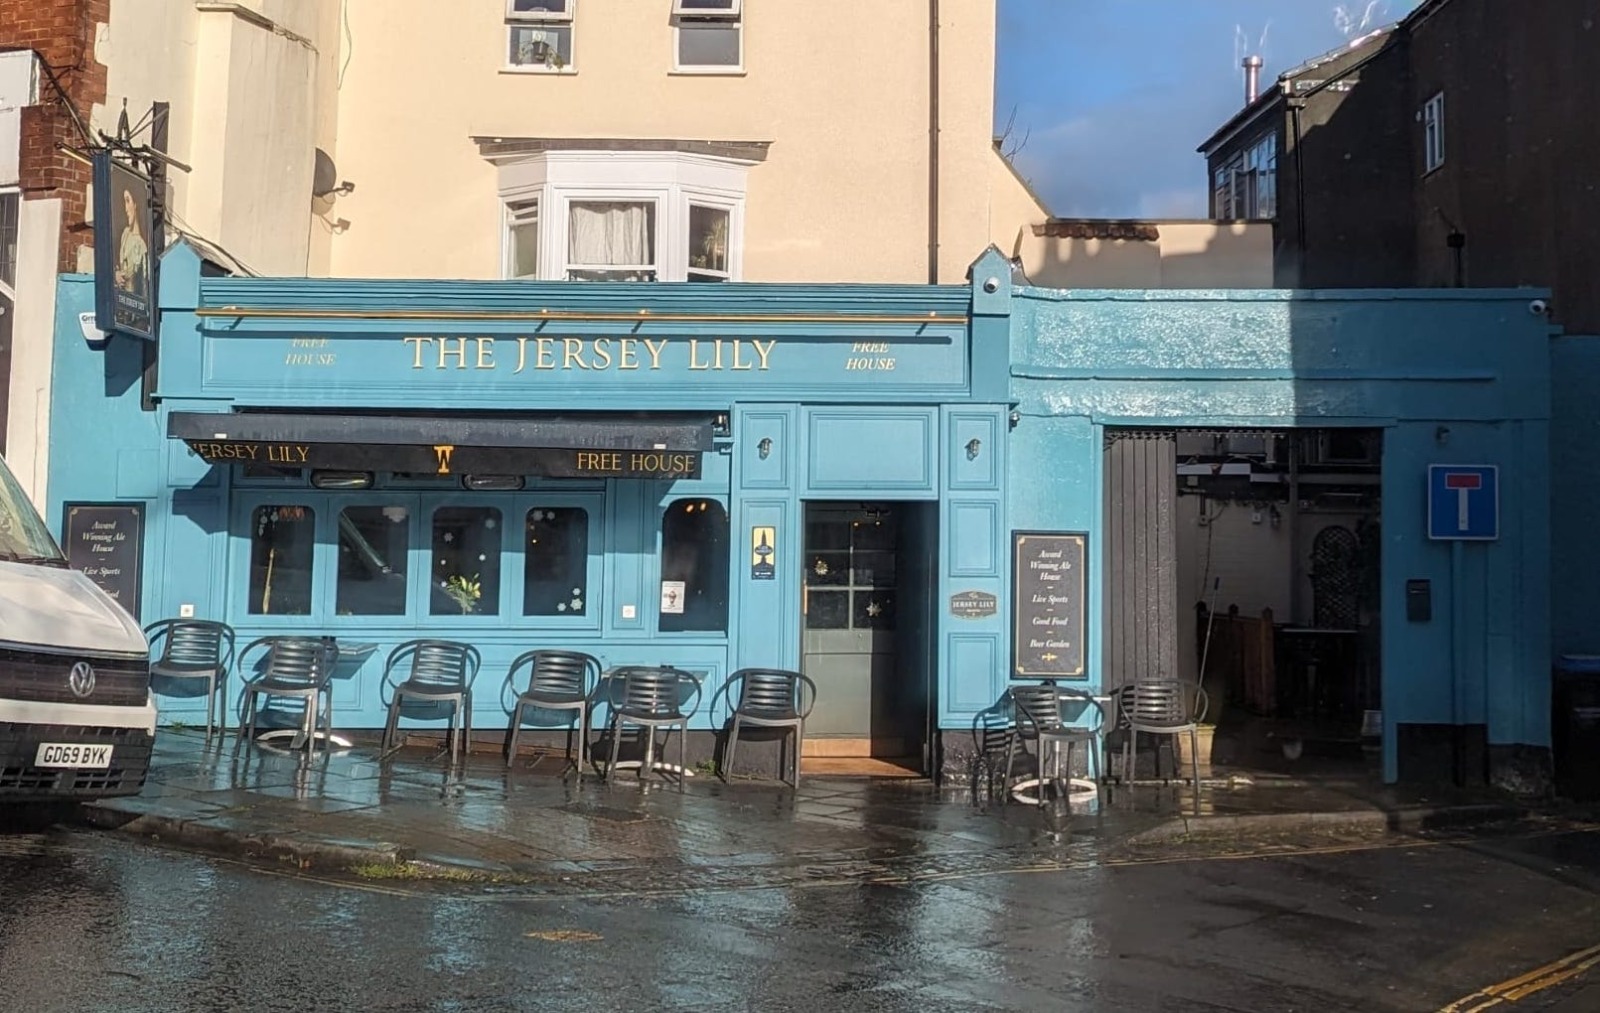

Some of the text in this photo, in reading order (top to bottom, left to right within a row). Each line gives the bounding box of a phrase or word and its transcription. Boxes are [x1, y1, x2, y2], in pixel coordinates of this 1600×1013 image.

[291, 337, 329, 349] FREE
[851, 341, 890, 354] FREE
[285, 353, 336, 367] HOUSE
[404, 336, 778, 375] THE JERSEY LILY
[845, 357, 896, 371] HOUSE
[193, 444, 310, 462] ERSEY LILY
[577, 451, 696, 473] FREE HOUSE
[92, 521, 116, 530] Award
[82, 532, 126, 542] Winning Ale
[91, 543, 114, 552] House
[1038, 550, 1062, 558] Award
[82, 566, 121, 577] Live Sports
[1030, 561, 1071, 571] Winning Ale
[1040, 572, 1061, 580] House
[1032, 594, 1068, 605] Live Sports
[1032, 616, 1068, 625] Good Food
[1029, 639, 1070, 648] Beer Garden
[43, 746, 108, 764] GD69 BYK
